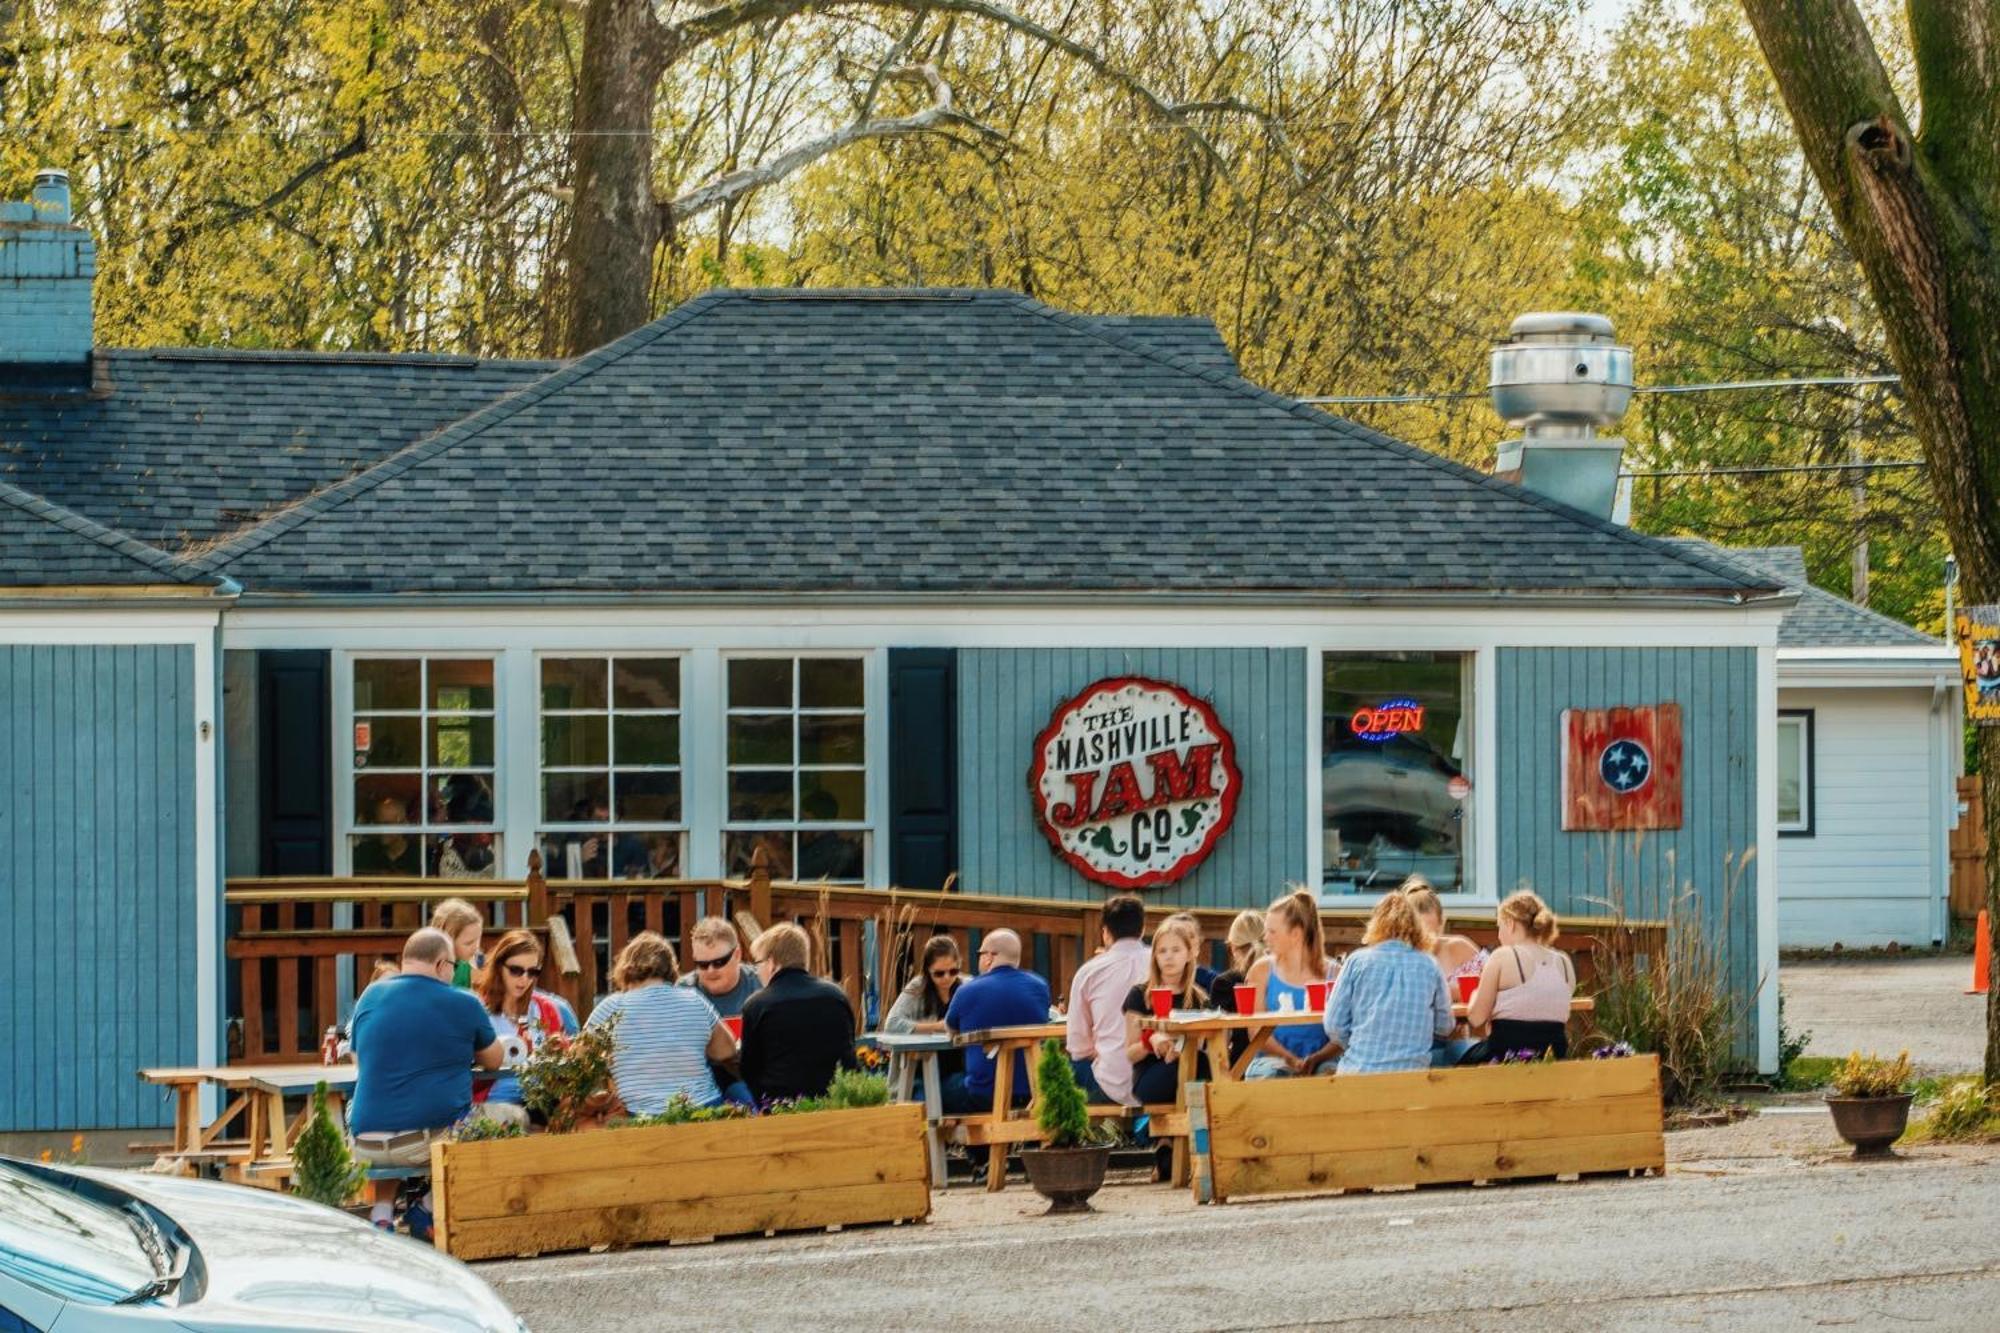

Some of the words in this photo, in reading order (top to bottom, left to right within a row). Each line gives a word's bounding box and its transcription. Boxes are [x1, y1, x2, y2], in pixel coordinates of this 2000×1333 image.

[1056, 710, 1190, 771] NASHVILLE
[1084, 706, 1134, 732] THE
[1351, 707, 1425, 733] OPEN
[1052, 743, 1222, 829] JAM
